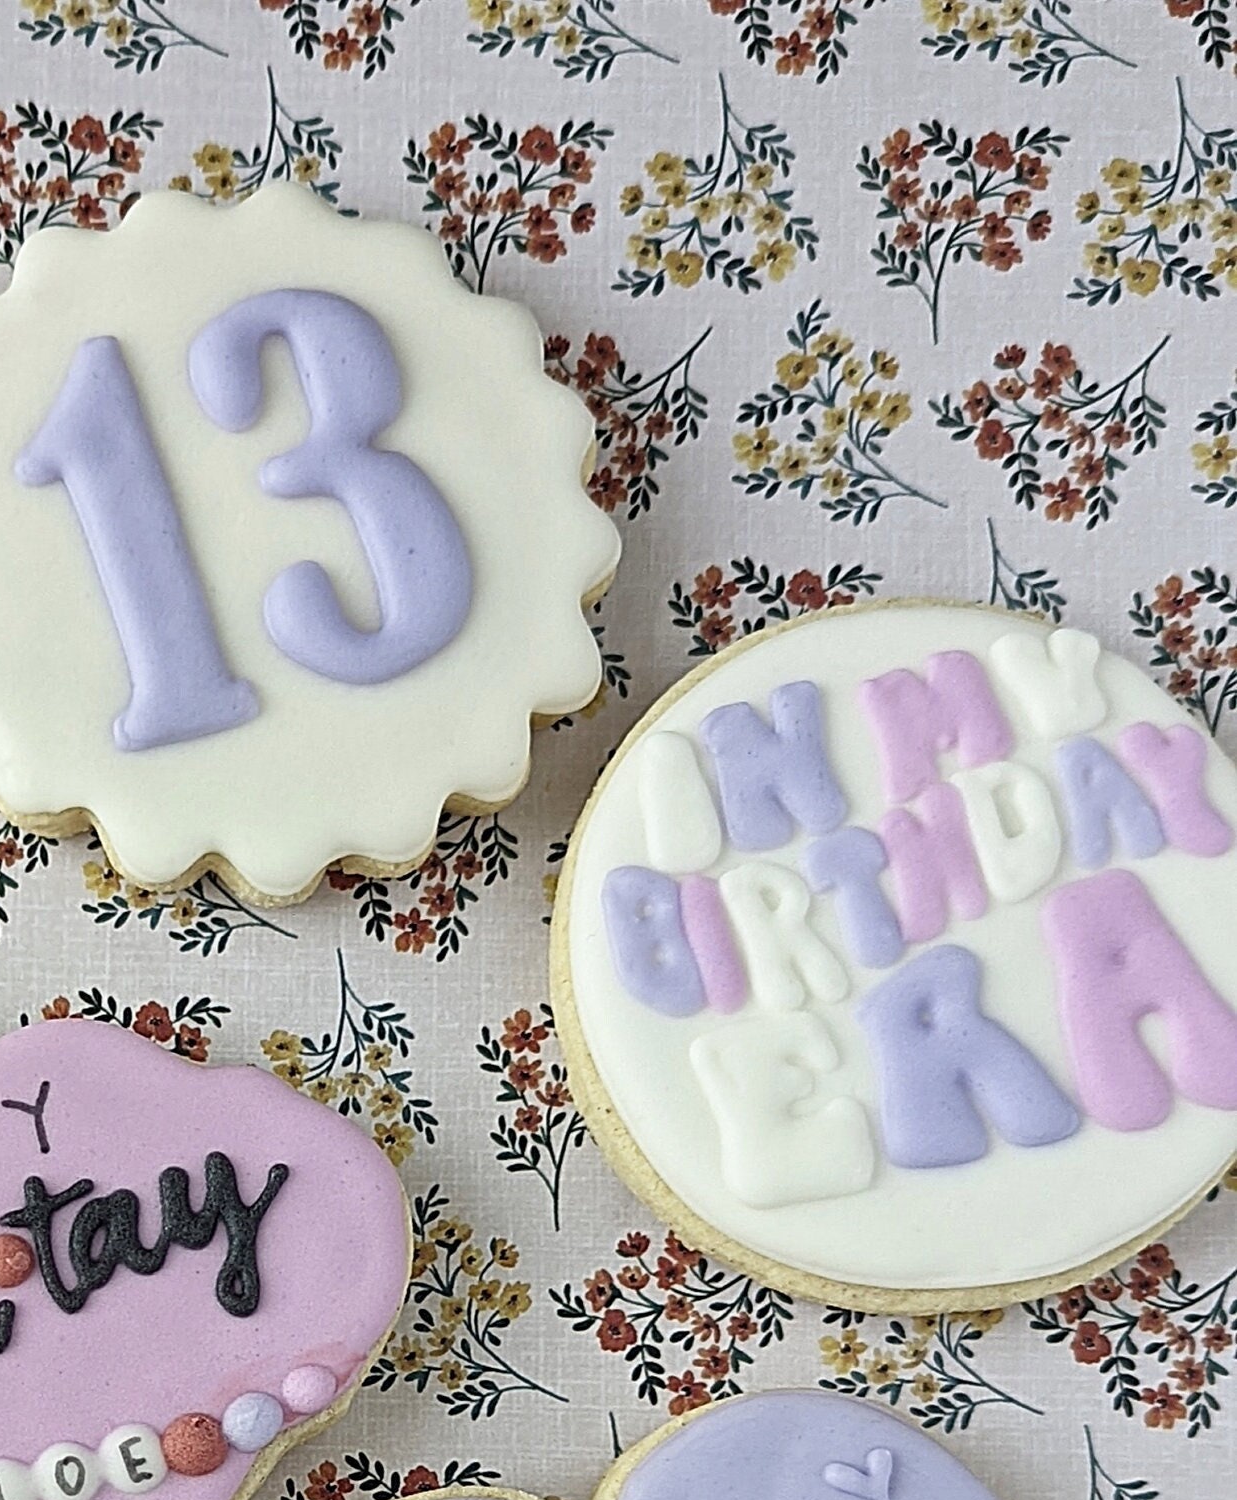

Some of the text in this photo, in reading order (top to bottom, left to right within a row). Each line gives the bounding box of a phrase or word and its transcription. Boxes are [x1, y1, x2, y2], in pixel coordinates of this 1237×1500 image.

[14, 288, 472, 753] 13
[601, 720, 1235, 1017] BIRTHDAY
[638, 628, 1106, 872] IN MY
[689, 868, 1237, 1209] ERA
